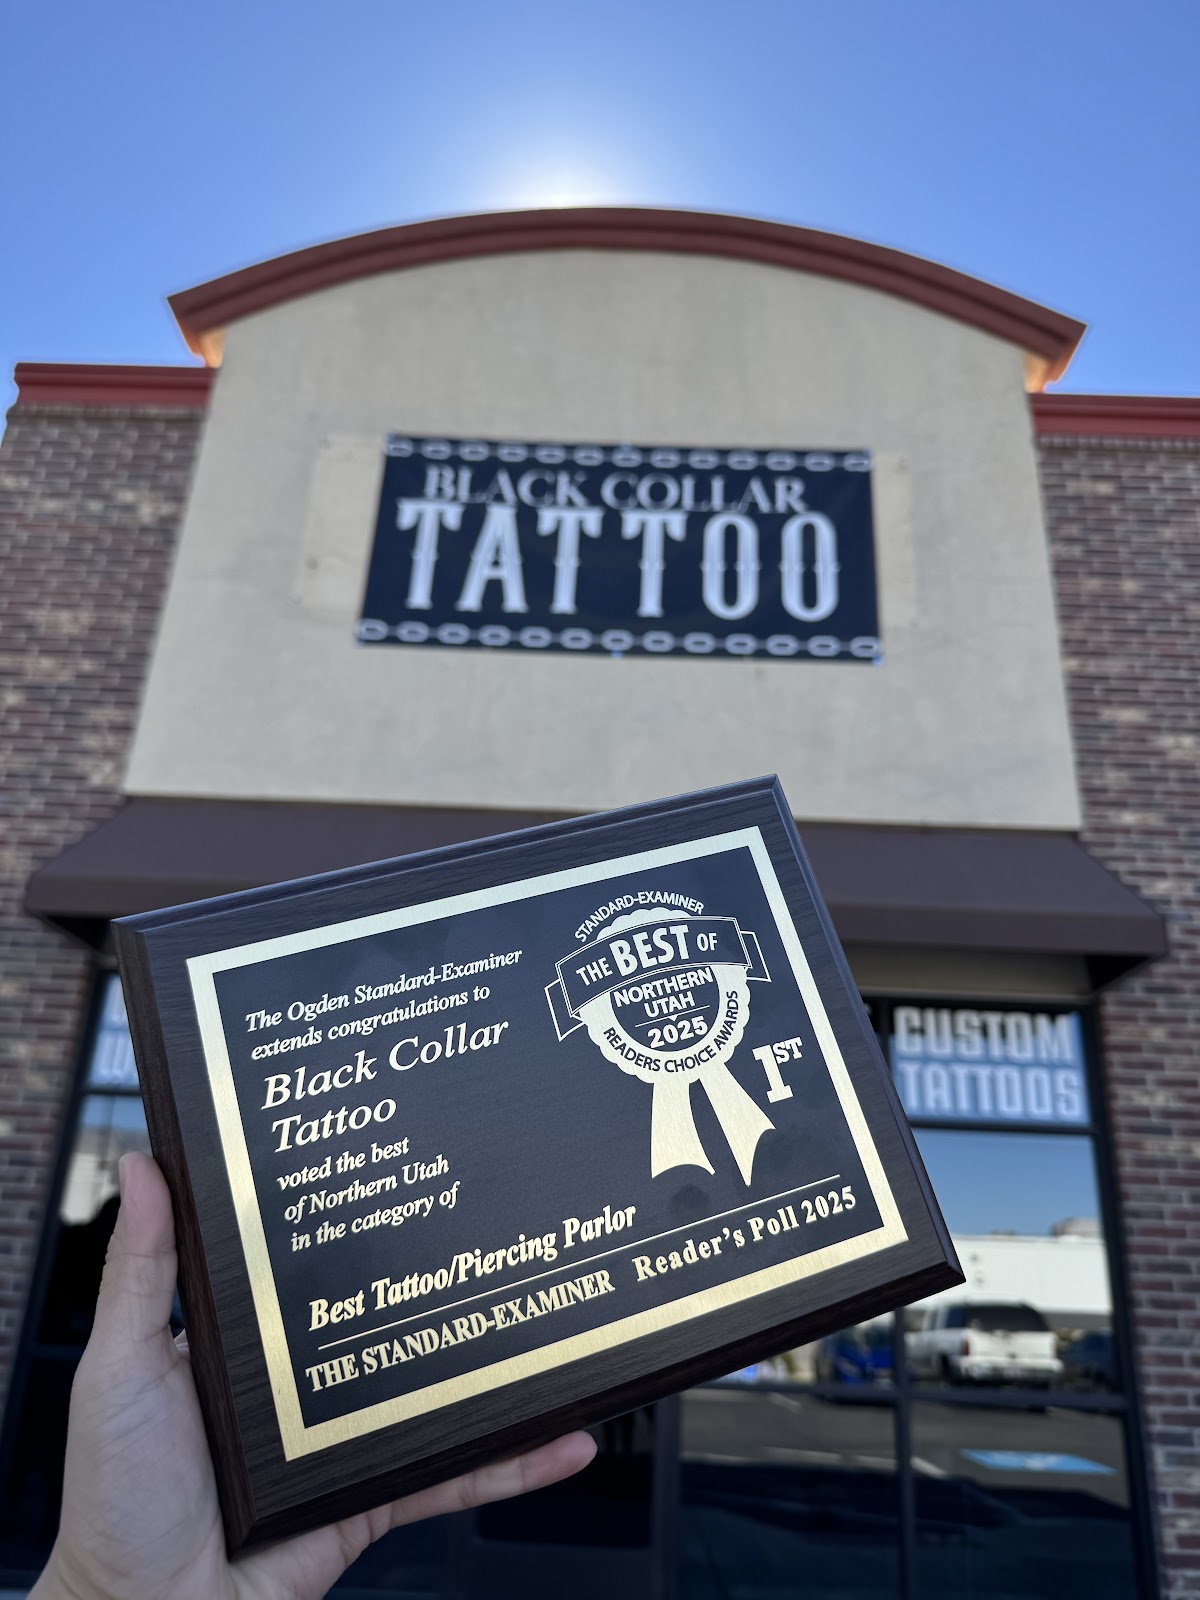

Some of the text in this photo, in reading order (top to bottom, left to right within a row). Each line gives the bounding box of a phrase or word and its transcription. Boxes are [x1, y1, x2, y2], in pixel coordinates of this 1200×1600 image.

[423, 463, 808, 514] BLACK COLLAR
[396, 498, 840, 622] TATTOO
[575, 891, 705, 943] STANDARD-EXAMINER
[576, 924, 718, 986] THE BEST OF
[613, 967, 713, 1008] NORTHERN
[246, 950, 523, 1032] The Ogden Standard-Examiner
[251, 986, 491, 1060] extends congratulations to
[643, 991, 695, 1018] UTAH
[603, 990, 739, 1072] READERS CHOICE AWARDS
[647, 1016, 708, 1049] 2025
[893, 1006, 1074, 1061] CUSTOM
[260, 1021, 509, 1110] Black Collar
[899, 1061, 1081, 1116] TATTOOS
[272, 1098, 397, 1153] Tattoo
[277, 1137, 410, 1190] voted the best
[284, 1154, 449, 1223] of Northern Utah
[291, 1181, 461, 1251] in the category of
[632, 1185, 858, 1282] Reader's Poll 2025
[308, 1202, 637, 1331] Best Tattoo/Piercing Parlor
[305, 1269, 615, 1393] THE STANDARD-EXAMINER
